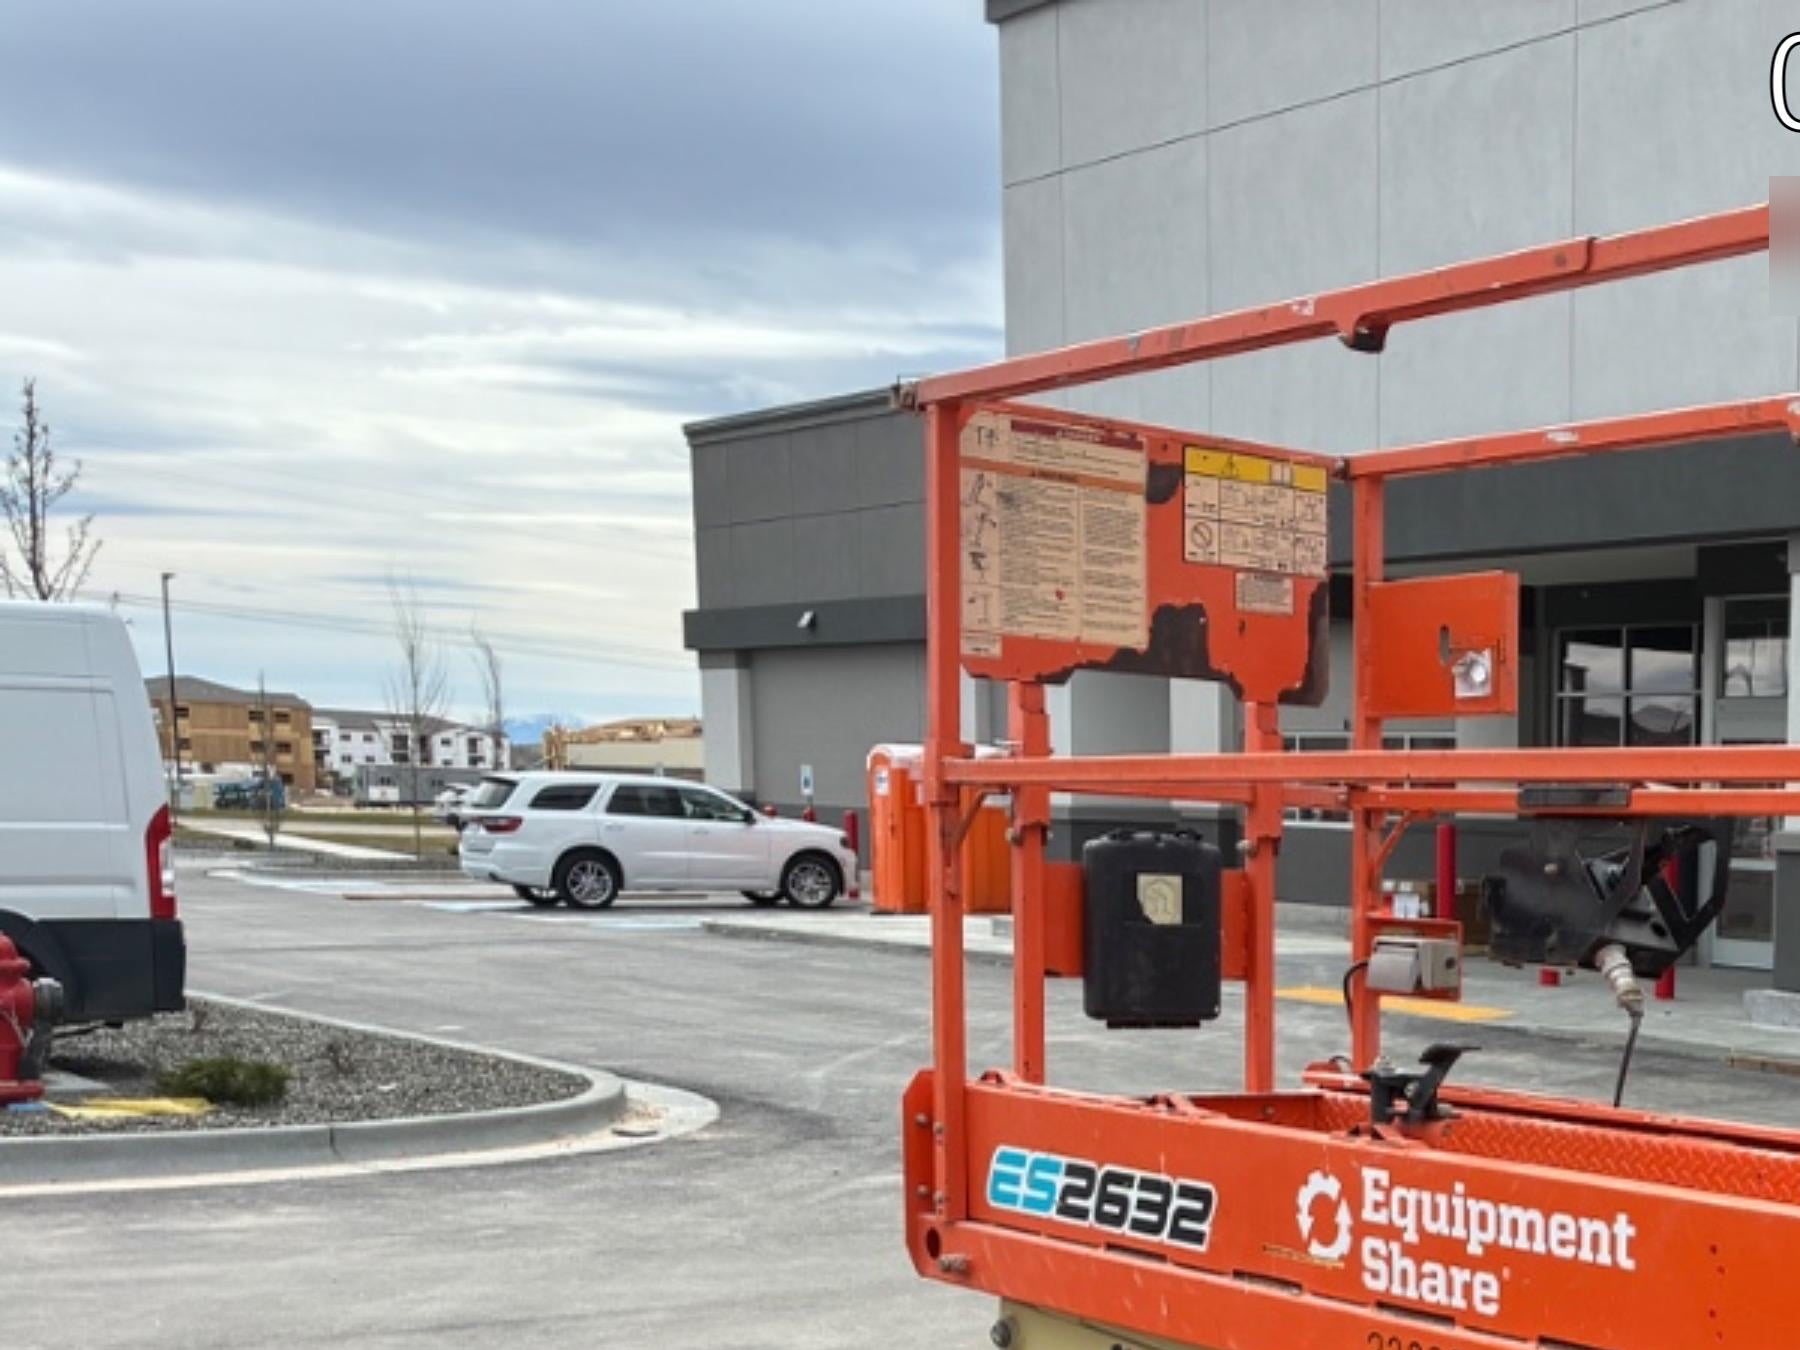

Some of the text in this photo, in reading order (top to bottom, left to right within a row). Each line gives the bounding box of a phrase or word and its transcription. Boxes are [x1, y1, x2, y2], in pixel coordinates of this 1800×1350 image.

[986, 1146, 1216, 1252] ES2632
[1360, 1166, 1636, 1270] Equipment
[1361, 1237, 1502, 1316] Share
